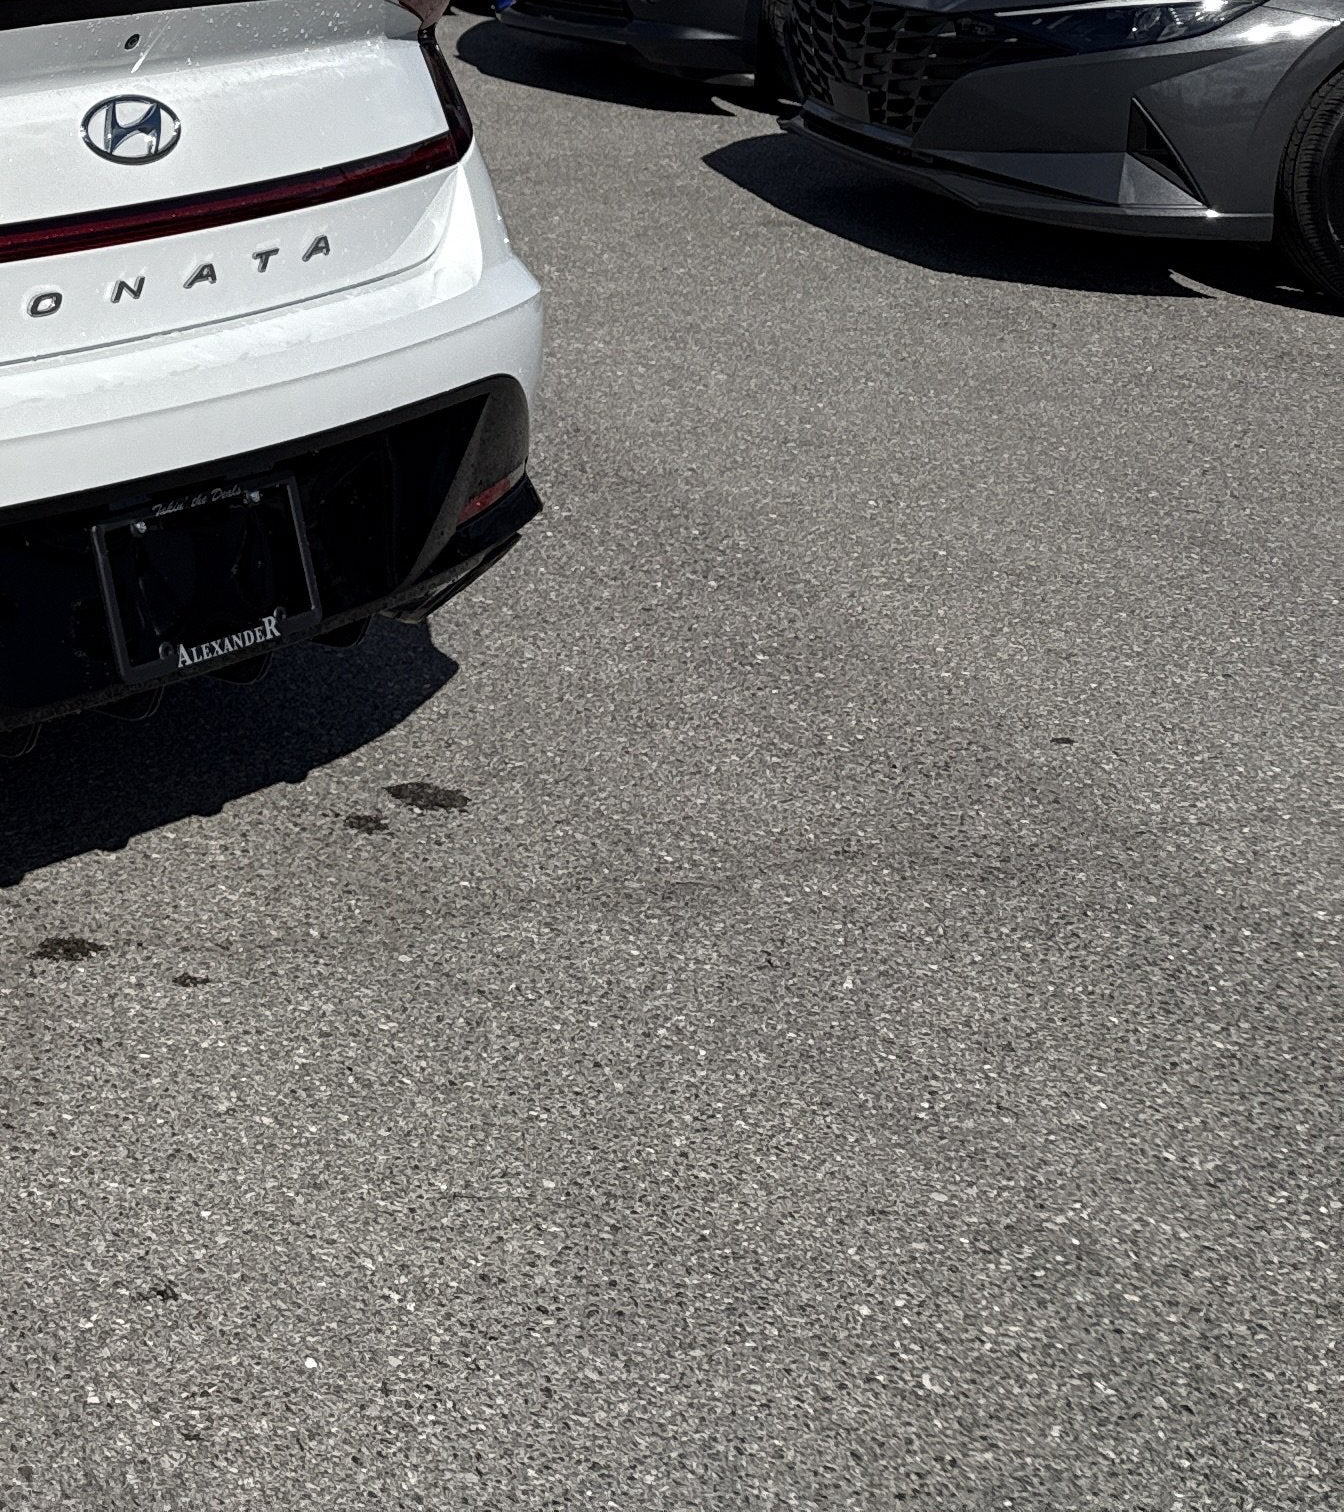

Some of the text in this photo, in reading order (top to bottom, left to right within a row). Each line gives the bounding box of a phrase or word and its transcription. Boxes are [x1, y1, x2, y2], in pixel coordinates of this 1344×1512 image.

[152, 484, 242, 517] Takin' the Deals
[177, 615, 281, 668] ALEXANDER
